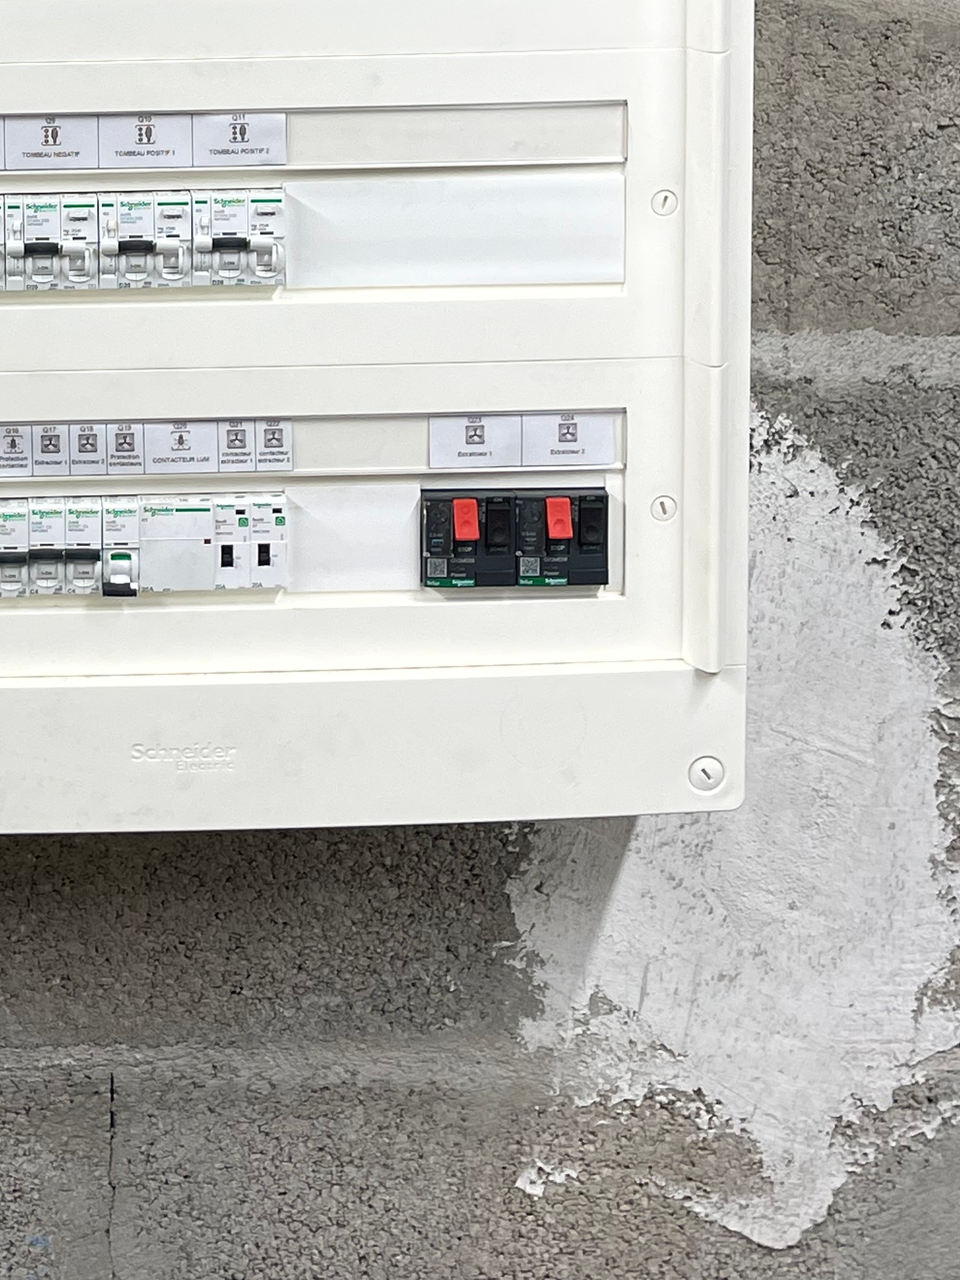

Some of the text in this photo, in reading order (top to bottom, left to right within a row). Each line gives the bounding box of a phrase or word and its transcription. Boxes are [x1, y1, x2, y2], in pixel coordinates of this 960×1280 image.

[120, 201, 151, 210] Schneider
[214, 198, 246, 207] Schneider
[26, 204, 58, 212] Schneider
[152, 456, 195, 464] CONTACTEUR
[31, 509, 63, 518] Schneider
[68, 508, 99, 518] Schneider
[105, 508, 137, 517] Schneider
[143, 507, 174, 516] Schneider
[131, 742, 237, 763] Schneider
